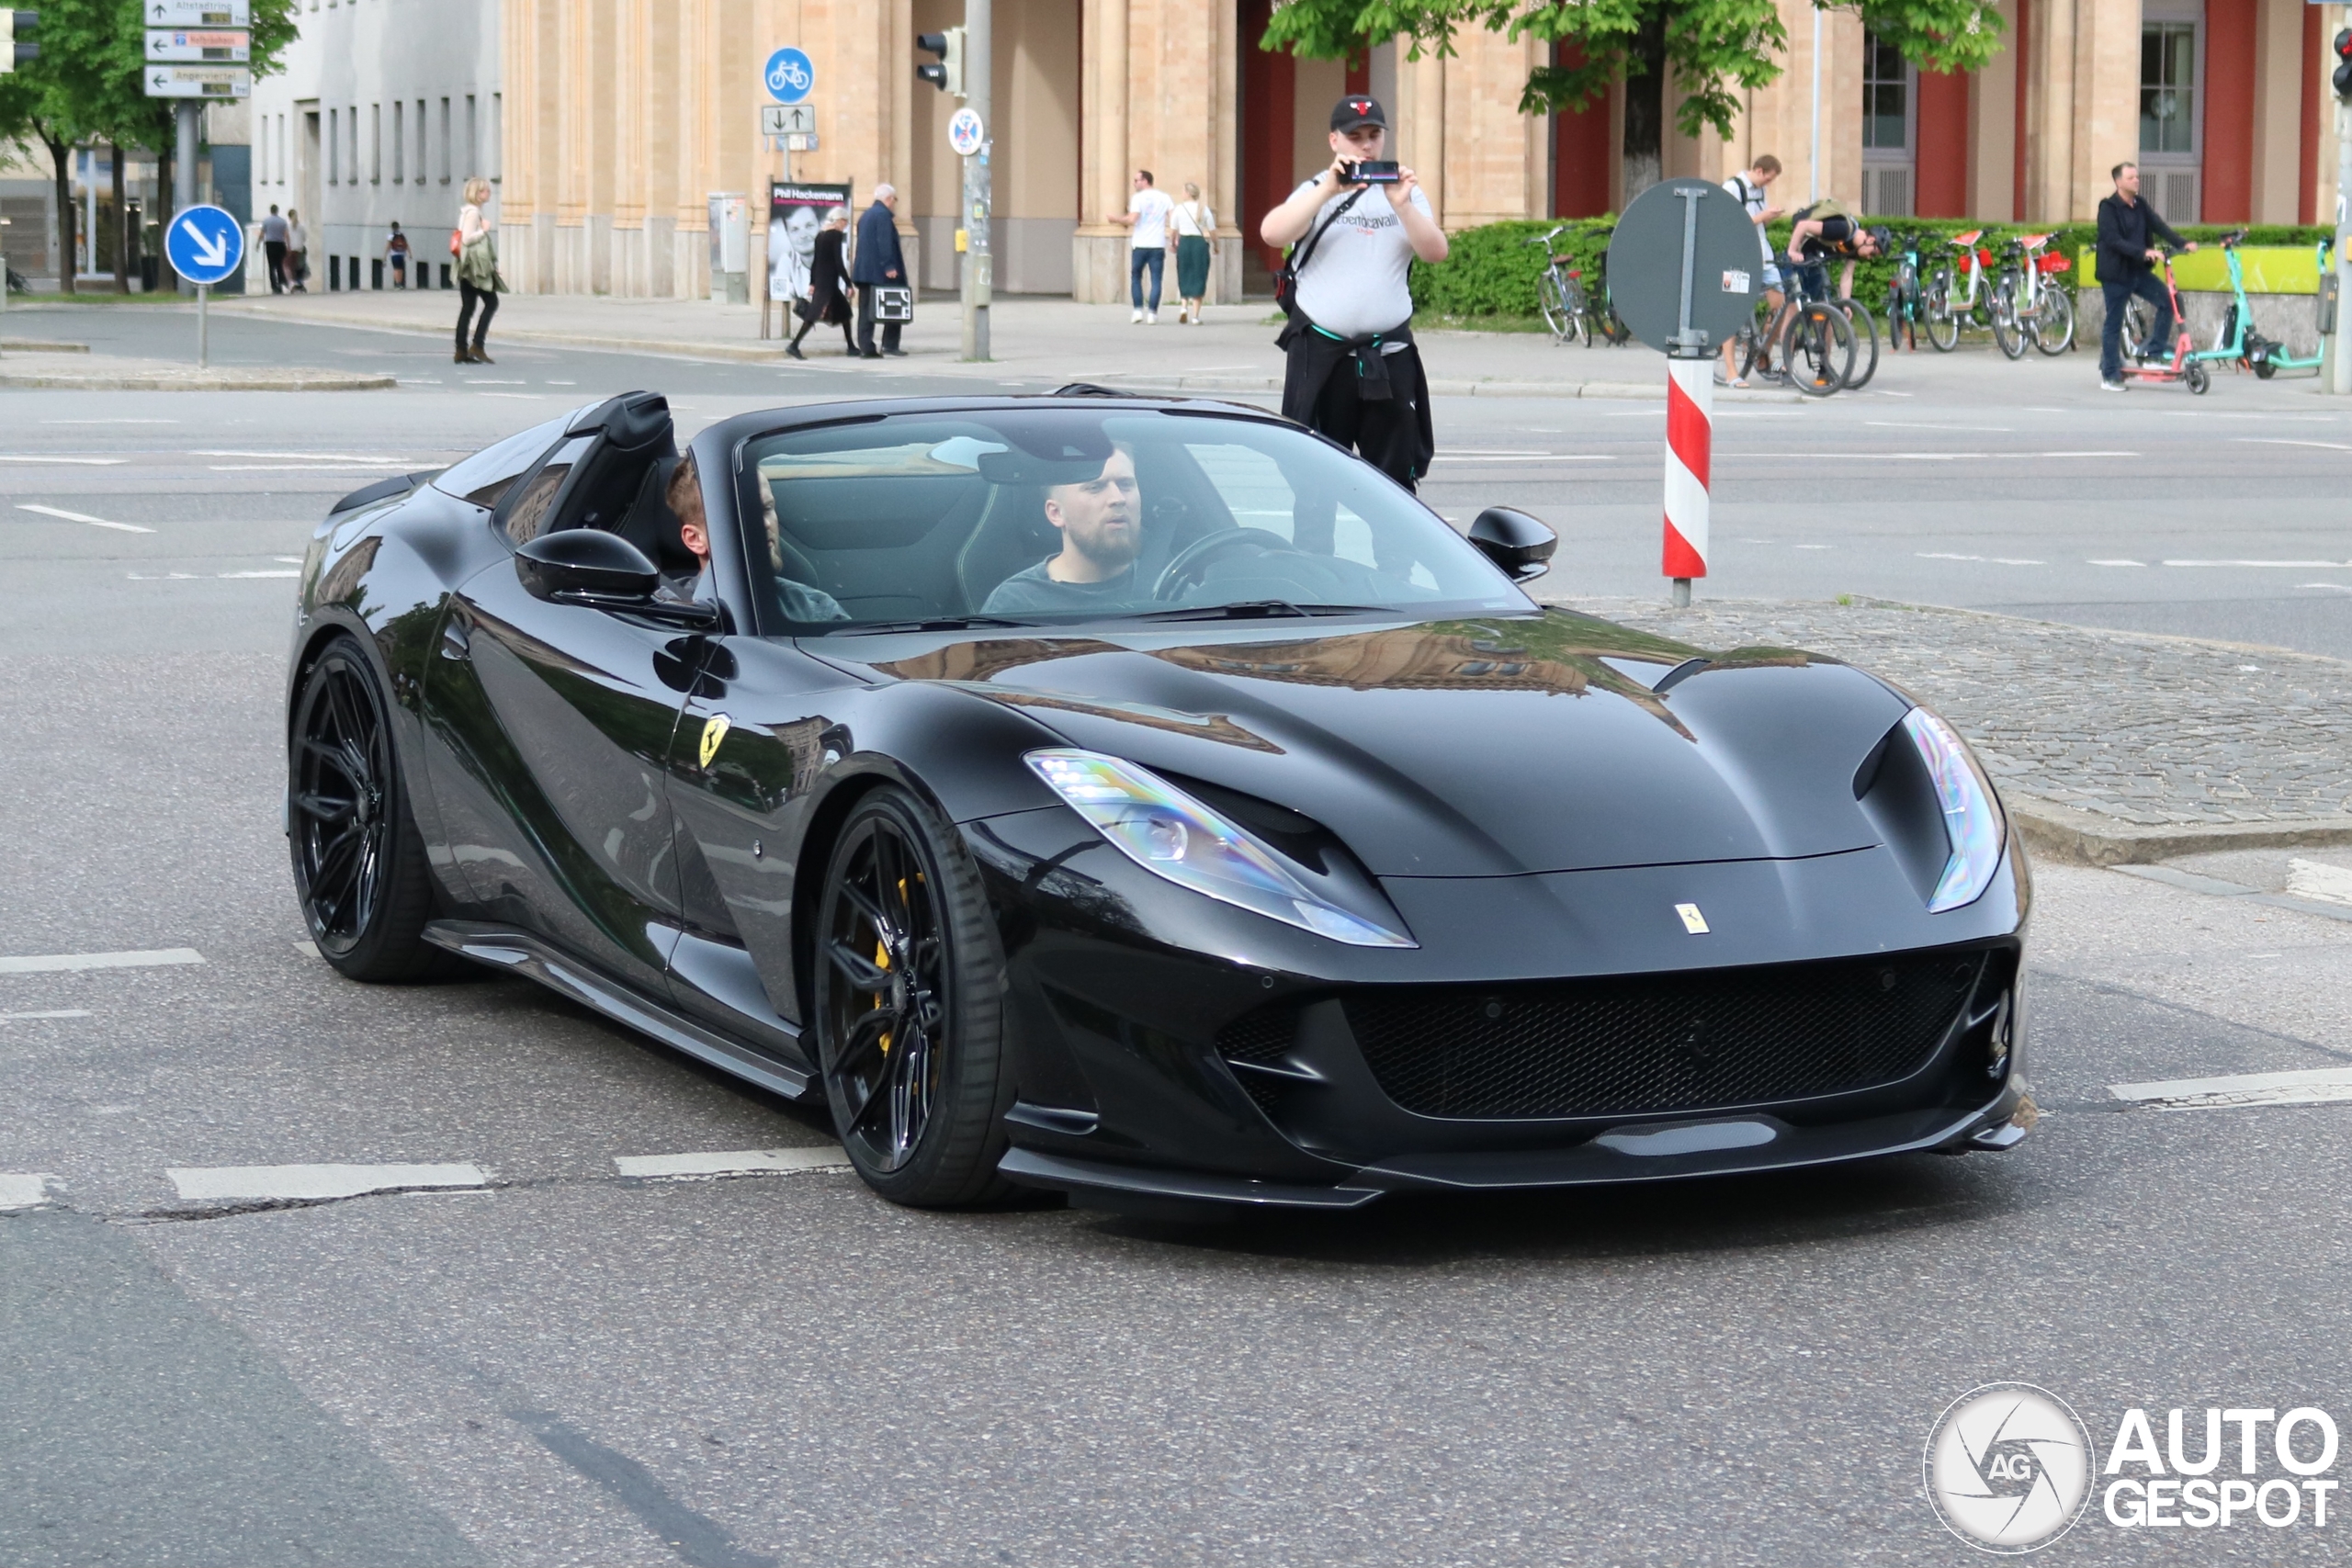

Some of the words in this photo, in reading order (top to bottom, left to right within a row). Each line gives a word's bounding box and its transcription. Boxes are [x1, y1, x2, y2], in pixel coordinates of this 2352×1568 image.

[175, 1, 232, 12] Altstadtring
[175, 72, 236, 82] Angerviertel
[774, 187, 790, 198] Phil
[792, 189, 844, 201] Hackemann
